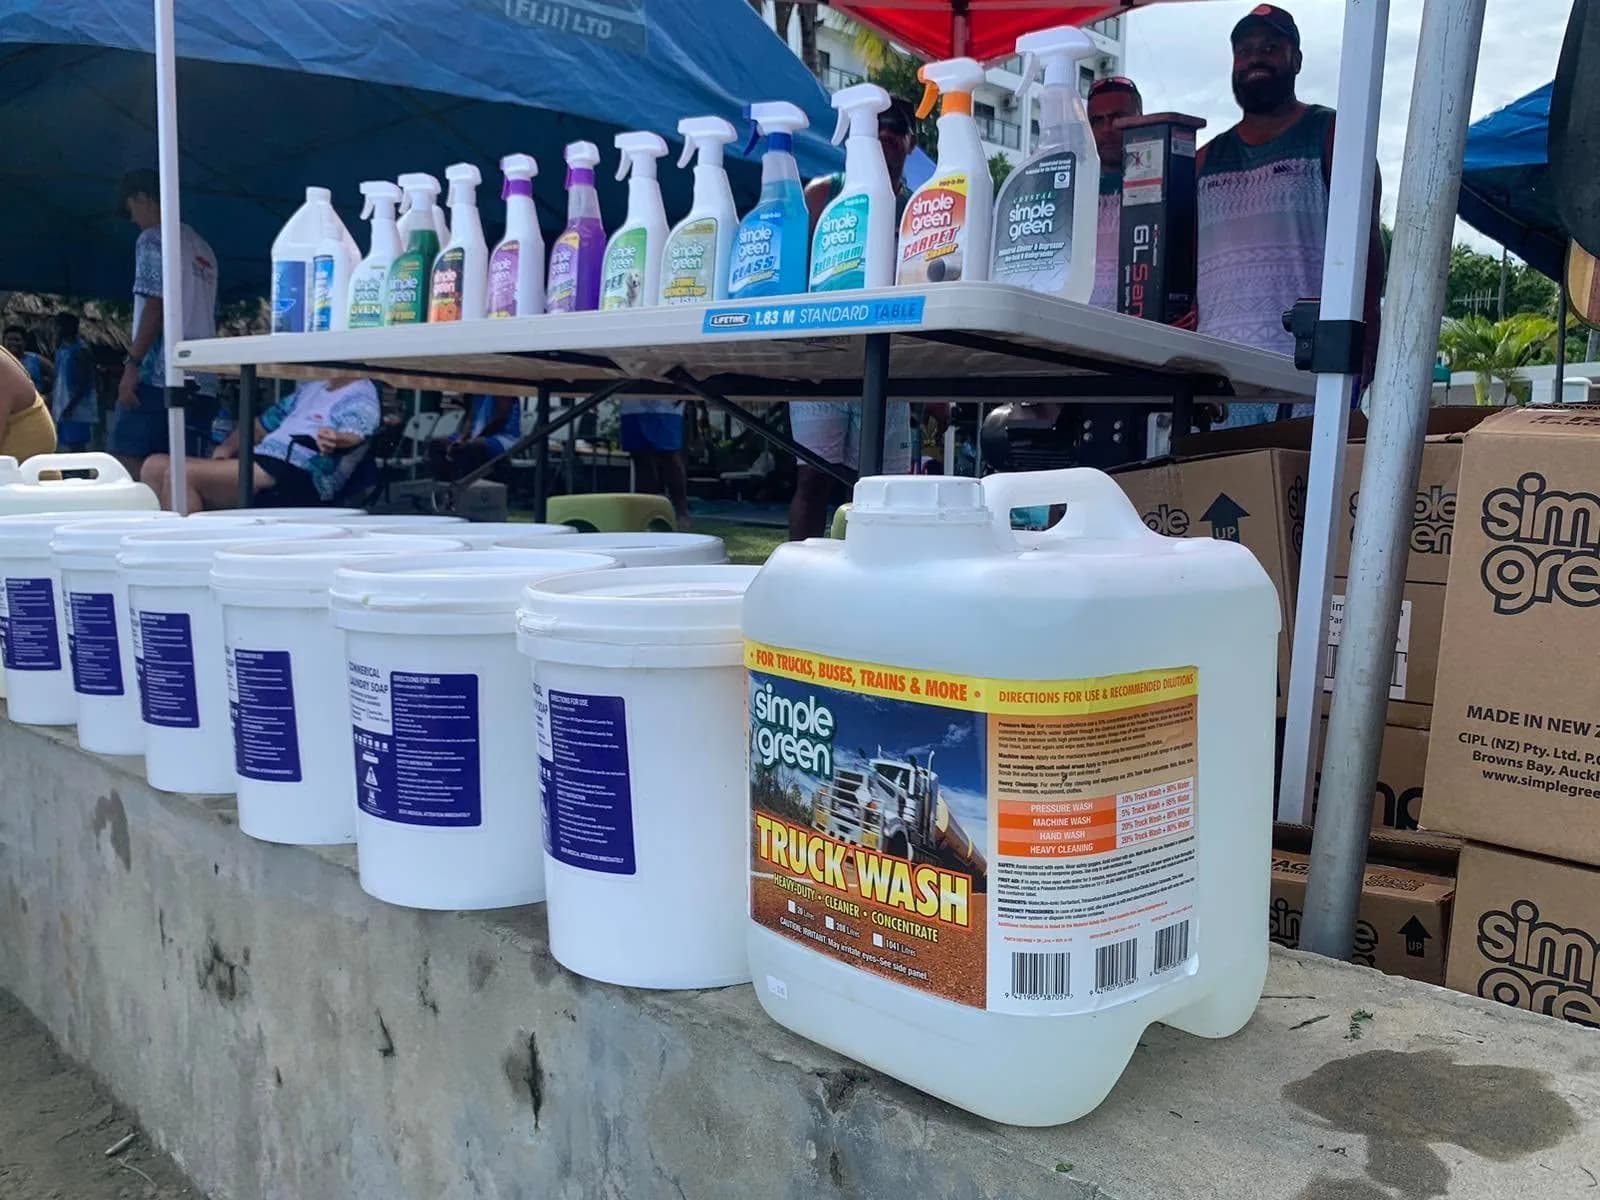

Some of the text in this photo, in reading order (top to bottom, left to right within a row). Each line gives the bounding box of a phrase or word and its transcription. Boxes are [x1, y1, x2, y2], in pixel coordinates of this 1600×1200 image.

[572, 13, 613, 39] LTD
[912, 194, 954, 215] simple
[1009, 200, 1055, 222] simple
[821, 213, 858, 232] simple
[911, 211, 951, 235] green
[1009, 219, 1053, 241] green
[739, 225, 771, 245] simple
[821, 230, 856, 250] green
[904, 227, 959, 260] CARPET
[671, 241, 704, 258] simple
[738, 242, 770, 262] green
[671, 257, 704, 275] green
[732, 256, 774, 282] GLASS
[605, 272, 625, 290] PET
[351, 304, 380, 314] OVEN
[713, 303, 917, 325] LIFETIME 1.83 M STANDARD TABLE
[1215, 527, 1236, 539] UP
[756, 650, 967, 702] FOR TRUCKS, BUSES, TRAINS & MORE
[371, 680, 389, 694] SOAP
[999, 674, 1194, 704] DIRECTIONS FOR USE & RECOMMENDED DILUTIONS
[755, 684, 834, 738] simple
[1467, 705, 1591, 736] MADE IN NEW
[756, 730, 831, 776] green
[1458, 732, 1488, 747] CIPL
[1491, 737, 1520, 753] (NZ)
[1523, 743, 1550, 759] Pty.
[1553, 748, 1580, 762] Ltd.
[1473, 750, 1523, 769] Browns
[1526, 760, 1556, 776] Bay,
[1122, 794, 1133, 804] 10%
[1134, 792, 1147, 801] Truck
[1147, 788, 1161, 797] Wash
[1031, 803, 1093, 813] PRESSURE WASH
[1121, 809, 1130, 817] 5%
[1132, 806, 1145, 815] Truck
[1146, 802, 1159, 811] Wash
[1033, 816, 1091, 826] MACHINE WASH
[1121, 822, 1133, 831] 20%
[1134, 819, 1147, 827] Truck
[1148, 815, 1161, 824] Wash
[1039, 830, 1085, 840] HAND WASH
[1134, 832, 1147, 840] Truck
[1148, 828, 1161, 837] Wash
[1030, 843, 1093, 854] HEAVY CLEANING
[756, 814, 969, 927] TRUCK WASH
[774, 875, 938, 942] HEAVY-DUTY CLEANER CONCENTRATE
[1408, 941, 1422, 951] UP
[1477, 900, 1600, 985] sim
[828, 938, 840, 951] May
[893, 961, 907, 973] side
[907, 966, 929, 980] panel.
